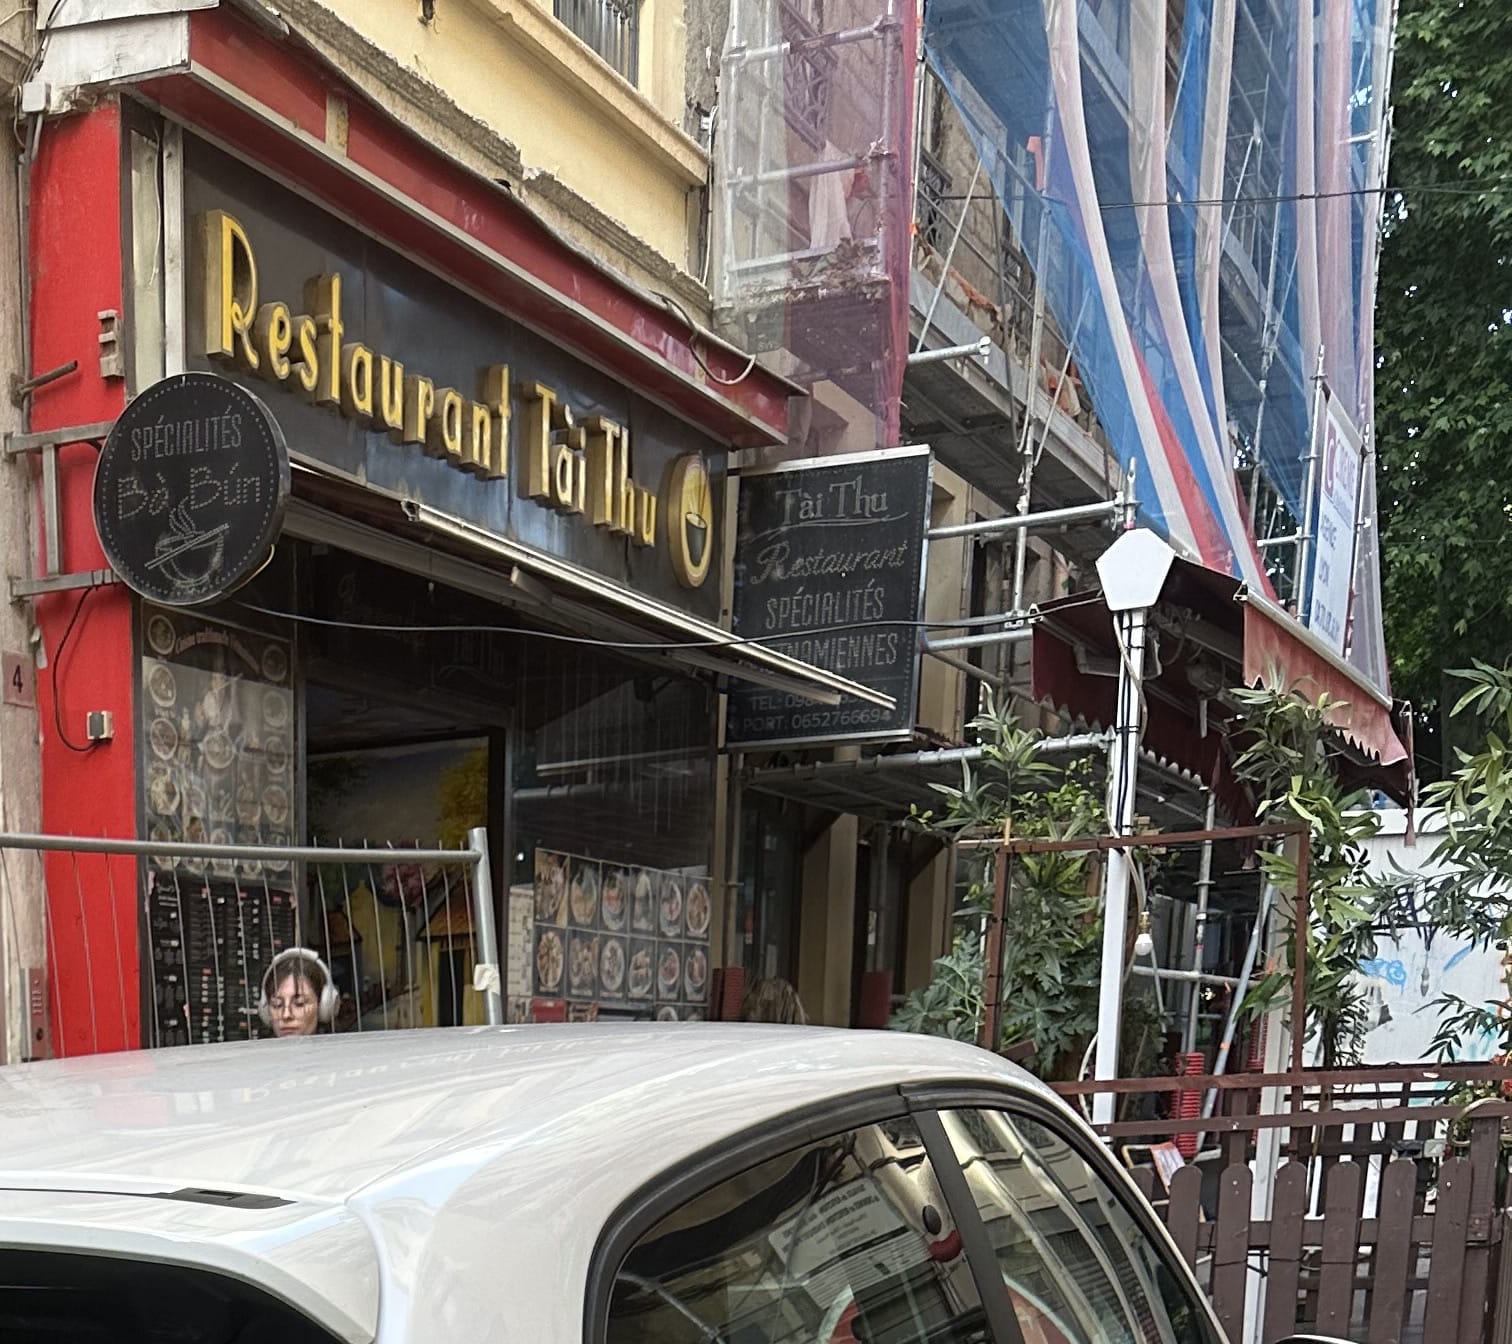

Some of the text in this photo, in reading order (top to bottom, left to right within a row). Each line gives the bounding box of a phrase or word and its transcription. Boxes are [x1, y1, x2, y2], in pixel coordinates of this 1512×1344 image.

[210, 211, 657, 547] Restaurant Tài Thu
[130, 405, 243, 462] SPÉCIALITÉS
[190, 462, 261, 511] Bún
[829, 475, 889, 518] Thu
[750, 539, 909, 585] Restaurant
[765, 578, 885, 631] SPÉCIALITÉS
[766, 632, 898, 670] NAMIENNES
[12, 664, 24, 694] 4
